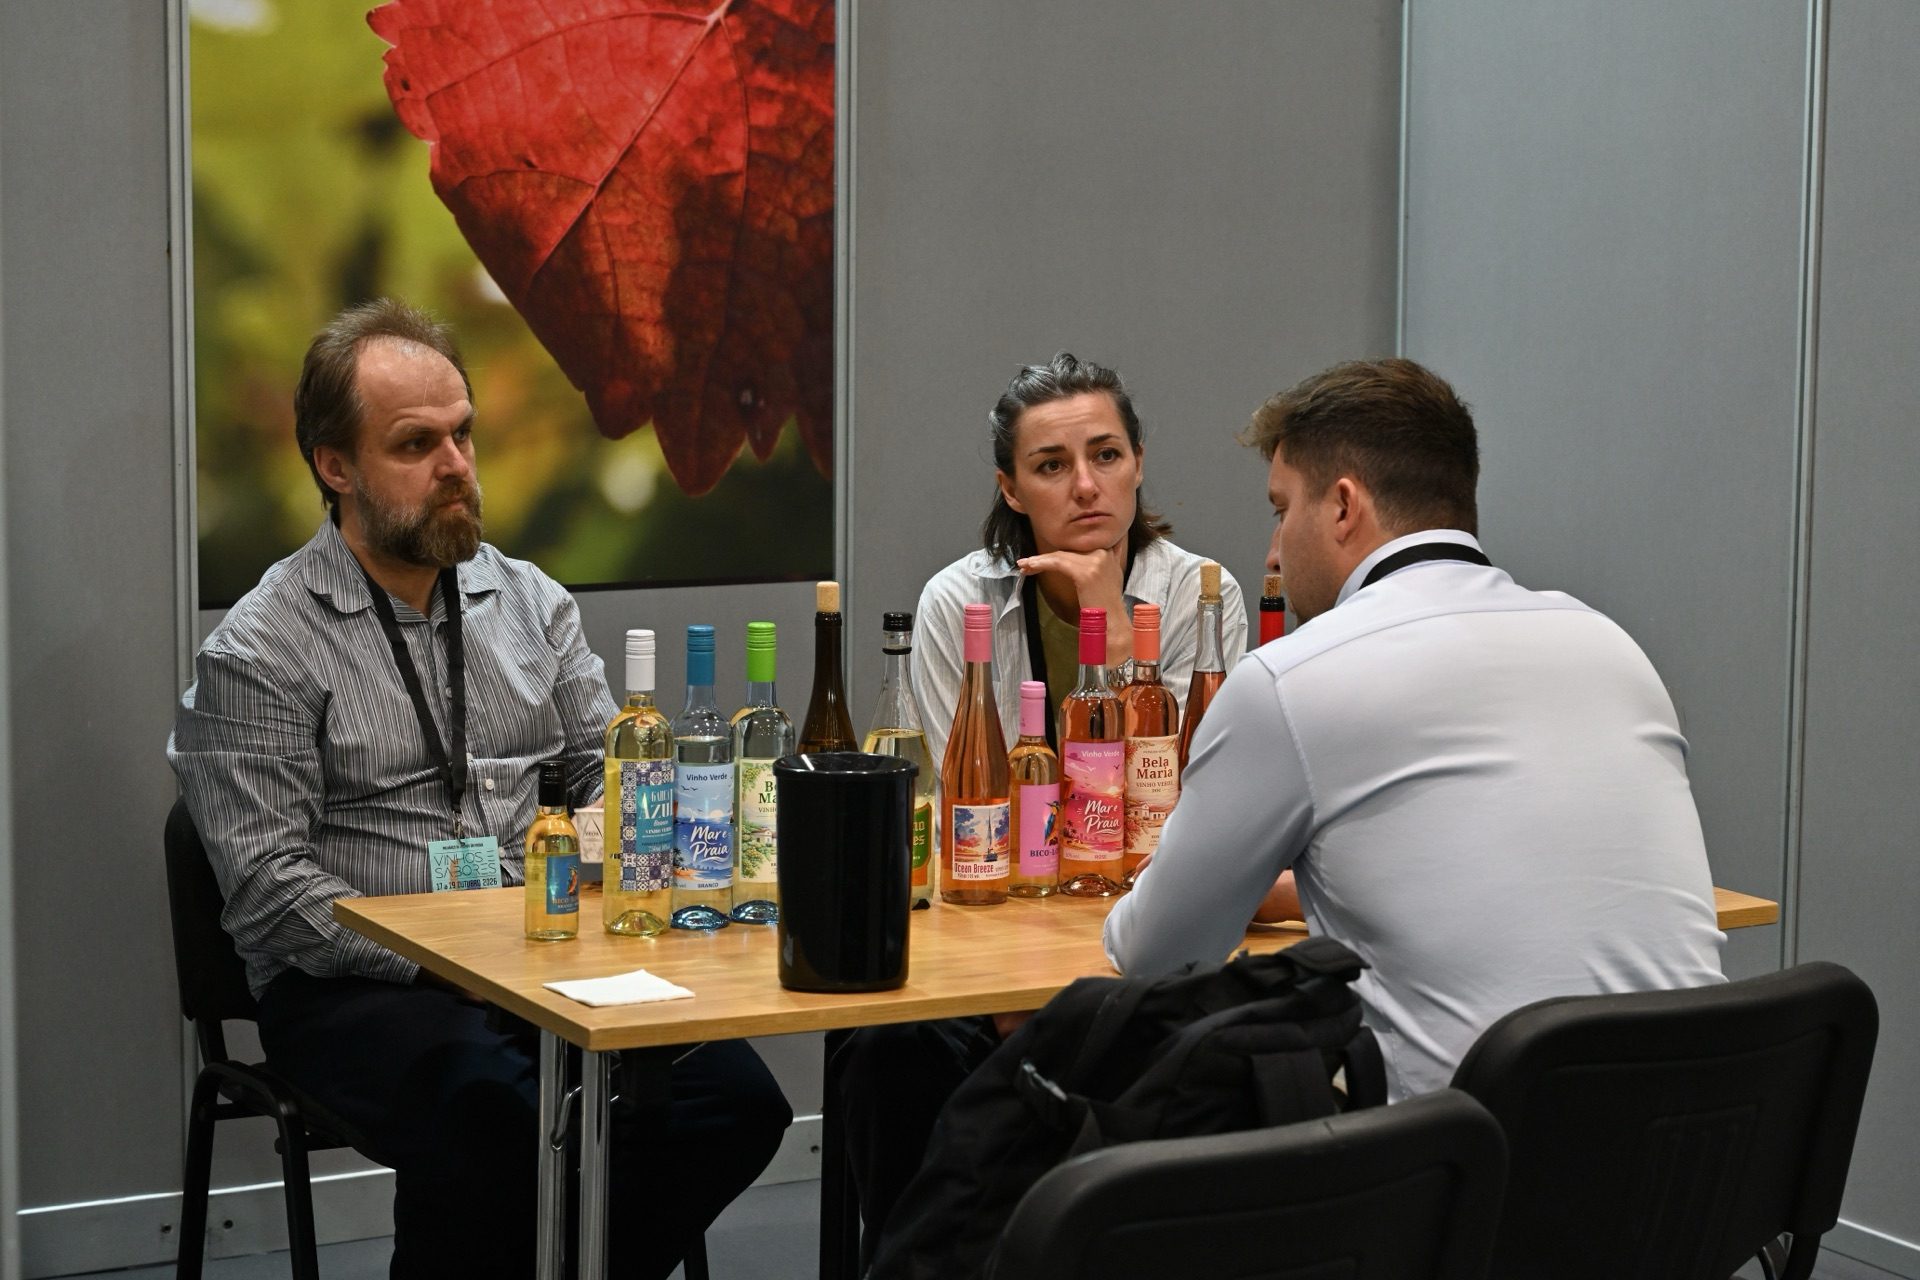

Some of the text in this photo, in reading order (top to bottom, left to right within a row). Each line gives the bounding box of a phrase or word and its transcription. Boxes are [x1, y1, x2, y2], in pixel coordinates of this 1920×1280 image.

[1142, 756, 1169, 768] Bela
[1136, 766, 1173, 780] Maria
[1084, 800, 1111, 816] Mar
[1084, 814, 1120, 833] Praia
[690, 825, 721, 844] Mar
[434, 852, 483, 866] VINHOS
[690, 842, 728, 861] Praia
[434, 863, 496, 878] SABORES
[954, 863, 971, 873] Ocean
[974, 864, 993, 873] Breeze
